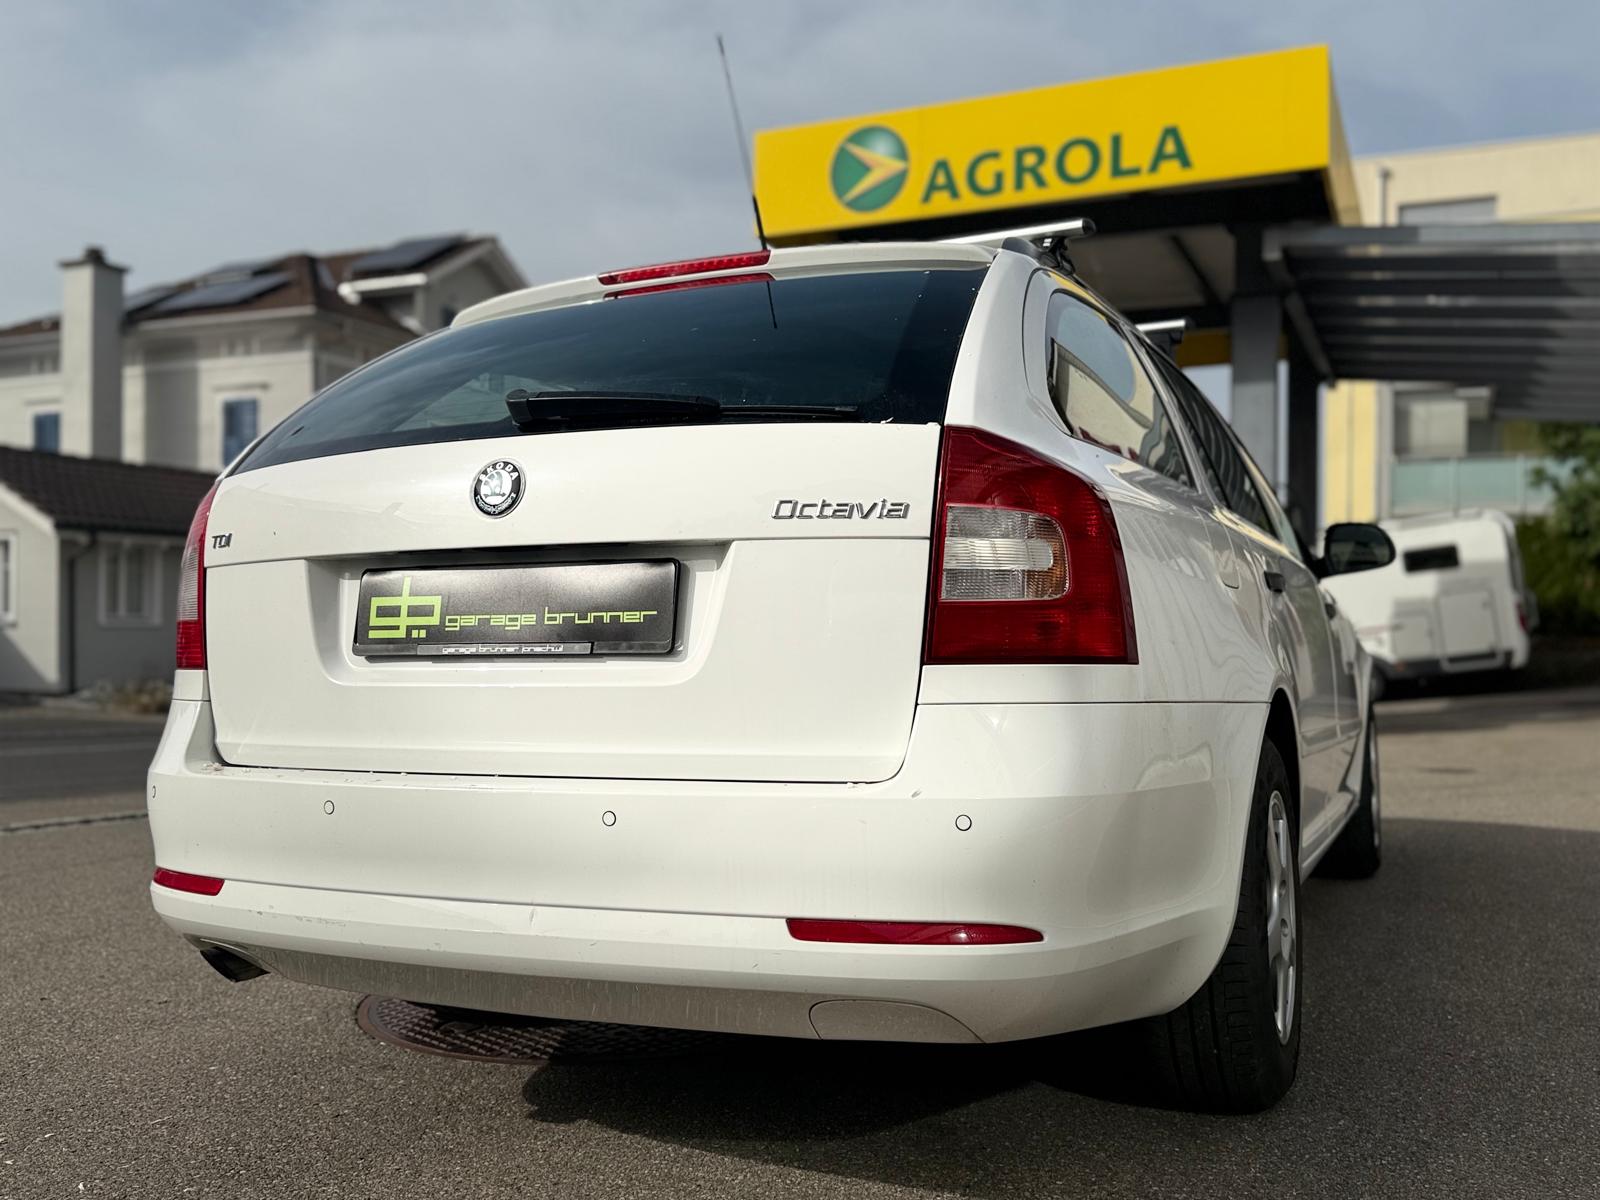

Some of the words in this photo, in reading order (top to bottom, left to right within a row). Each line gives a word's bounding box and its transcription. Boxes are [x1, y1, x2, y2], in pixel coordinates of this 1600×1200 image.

[922, 126, 1192, 203] AGROLA
[772, 498, 911, 519] Octavia
[212, 533, 232, 549] TDI
[445, 613, 536, 630] garage
[543, 607, 657, 625] brunner
